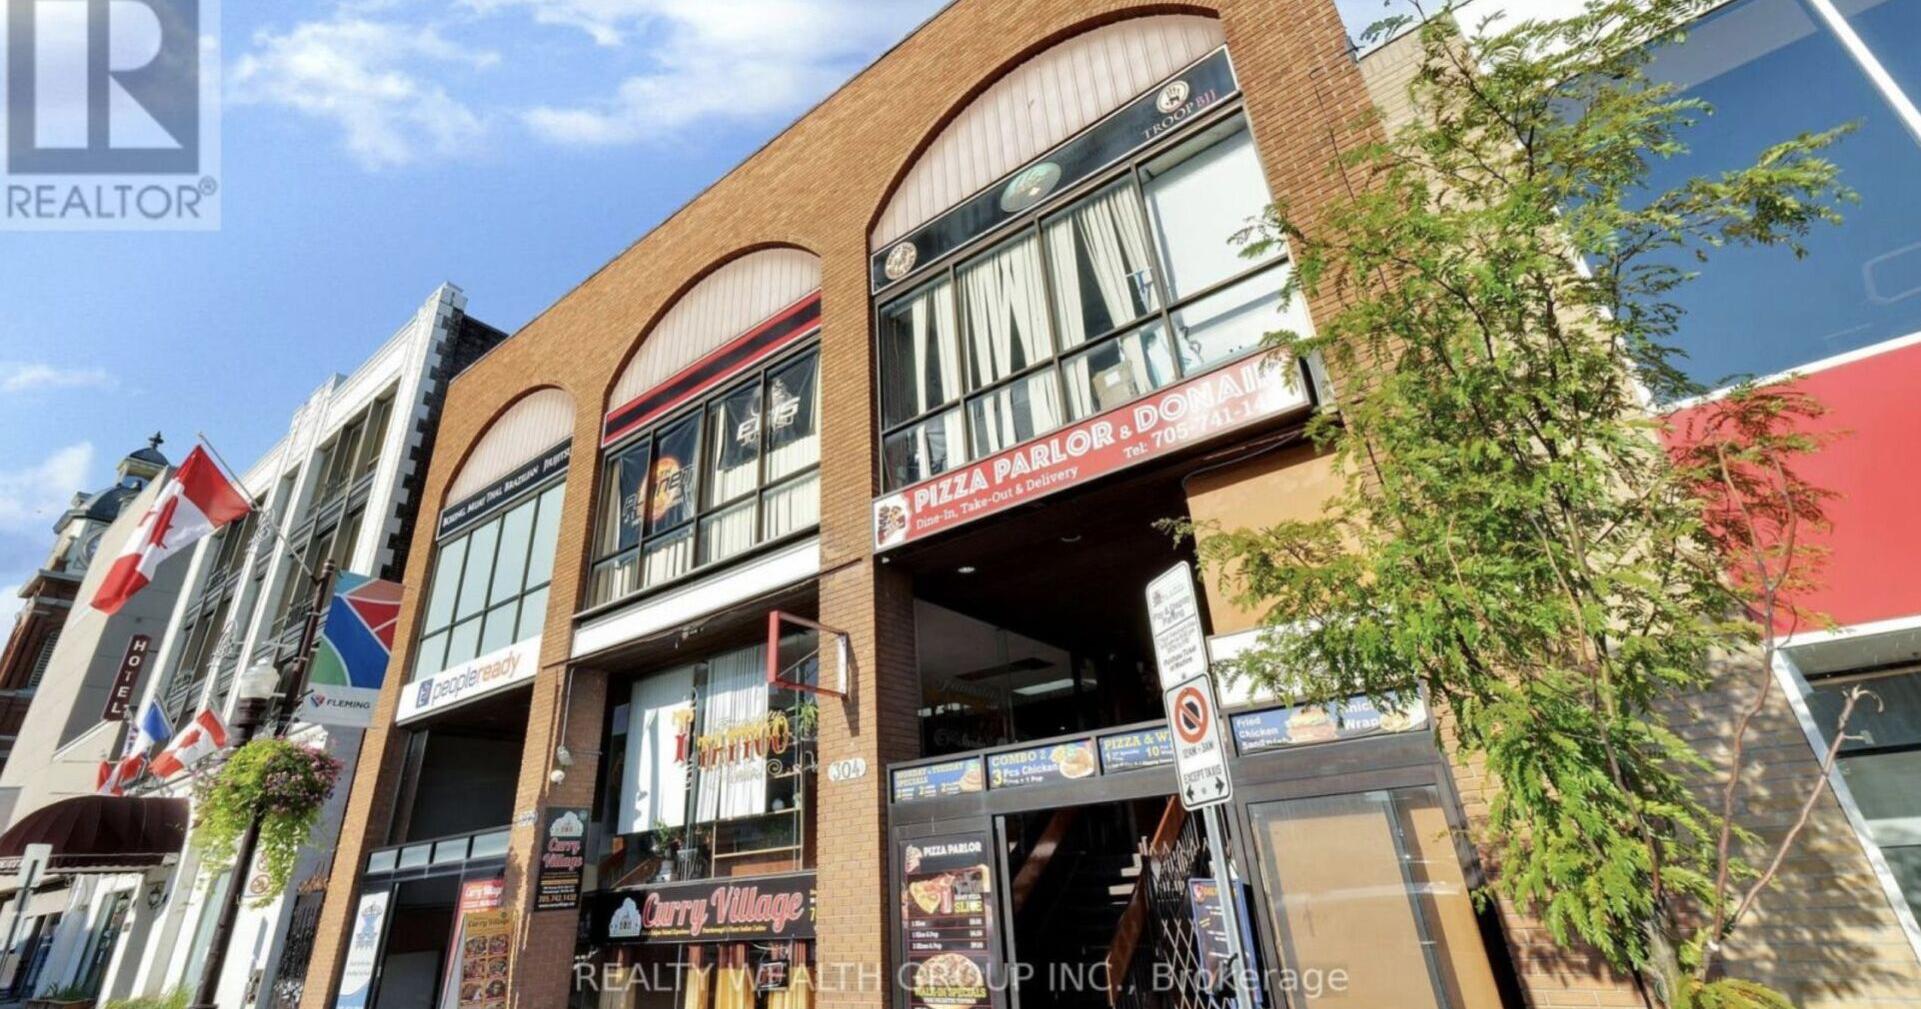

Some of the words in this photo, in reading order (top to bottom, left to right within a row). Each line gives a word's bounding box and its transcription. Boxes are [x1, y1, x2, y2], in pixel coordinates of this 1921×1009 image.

[1143, 101, 1194, 139] TROOP
[914, 467, 989, 513] PIZZA
[993, 420, 1115, 485] PARLOR
[1120, 424, 1133, 440] &
[916, 508, 959, 530] Dine-In,
[960, 490, 1014, 514] Take-Out
[1015, 483, 1025, 495] &
[1026, 466, 1079, 491] Delivery
[111, 640, 147, 713] HOTEL
[431, 650, 521, 706] peopleready
[327, 699, 370, 709] FLEMING
[1237, 716, 1262, 727] Fried
[1239, 727, 1279, 739] Chicken
[1104, 735, 1140, 750] PIZZA
[992, 750, 1037, 766] COMBO
[830, 760, 861, 779] 304
[992, 769, 1002, 785] 3
[547, 838, 581, 855] Curry
[923, 845, 946, 856] PIZZA
[947, 842, 982, 855] PARLOR
[542, 853, 583, 872] Village
[641, 892, 708, 936] Curry
[711, 886, 804, 933] Village
